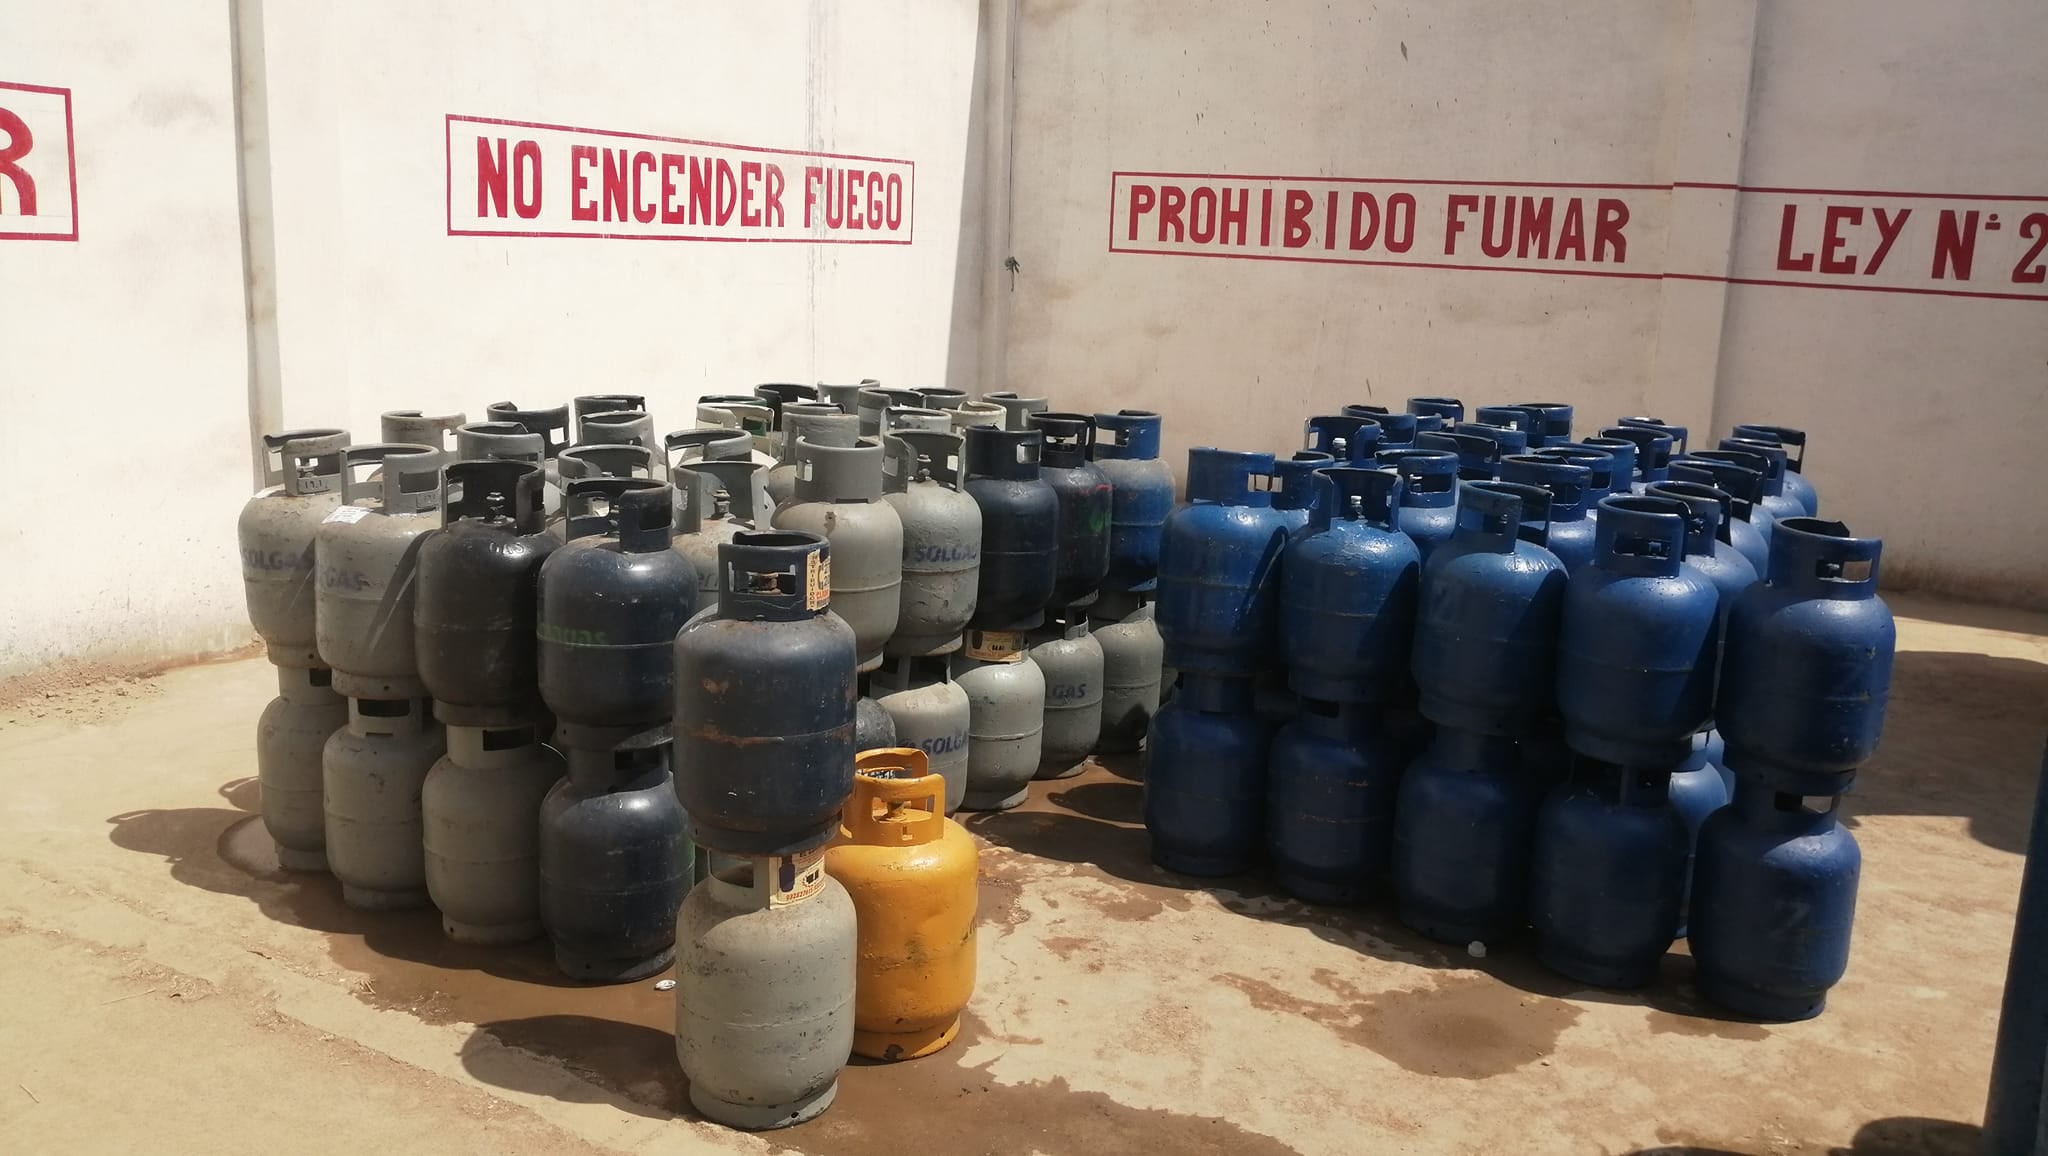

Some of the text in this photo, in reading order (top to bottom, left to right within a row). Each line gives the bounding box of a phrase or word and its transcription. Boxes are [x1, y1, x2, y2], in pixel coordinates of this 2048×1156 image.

[478, 137, 902, 231] NO ENCENDER FUEGO
[1128, 184, 1417, 254] PROHIBIDO
[1444, 194, 1631, 264] FUMAR
[1776, 205, 1912, 276] LEY
[2011, 212, 2048, 283] 2
[910, 543, 978, 563] SOLGA
[922, 730, 969, 755] SOLGA
